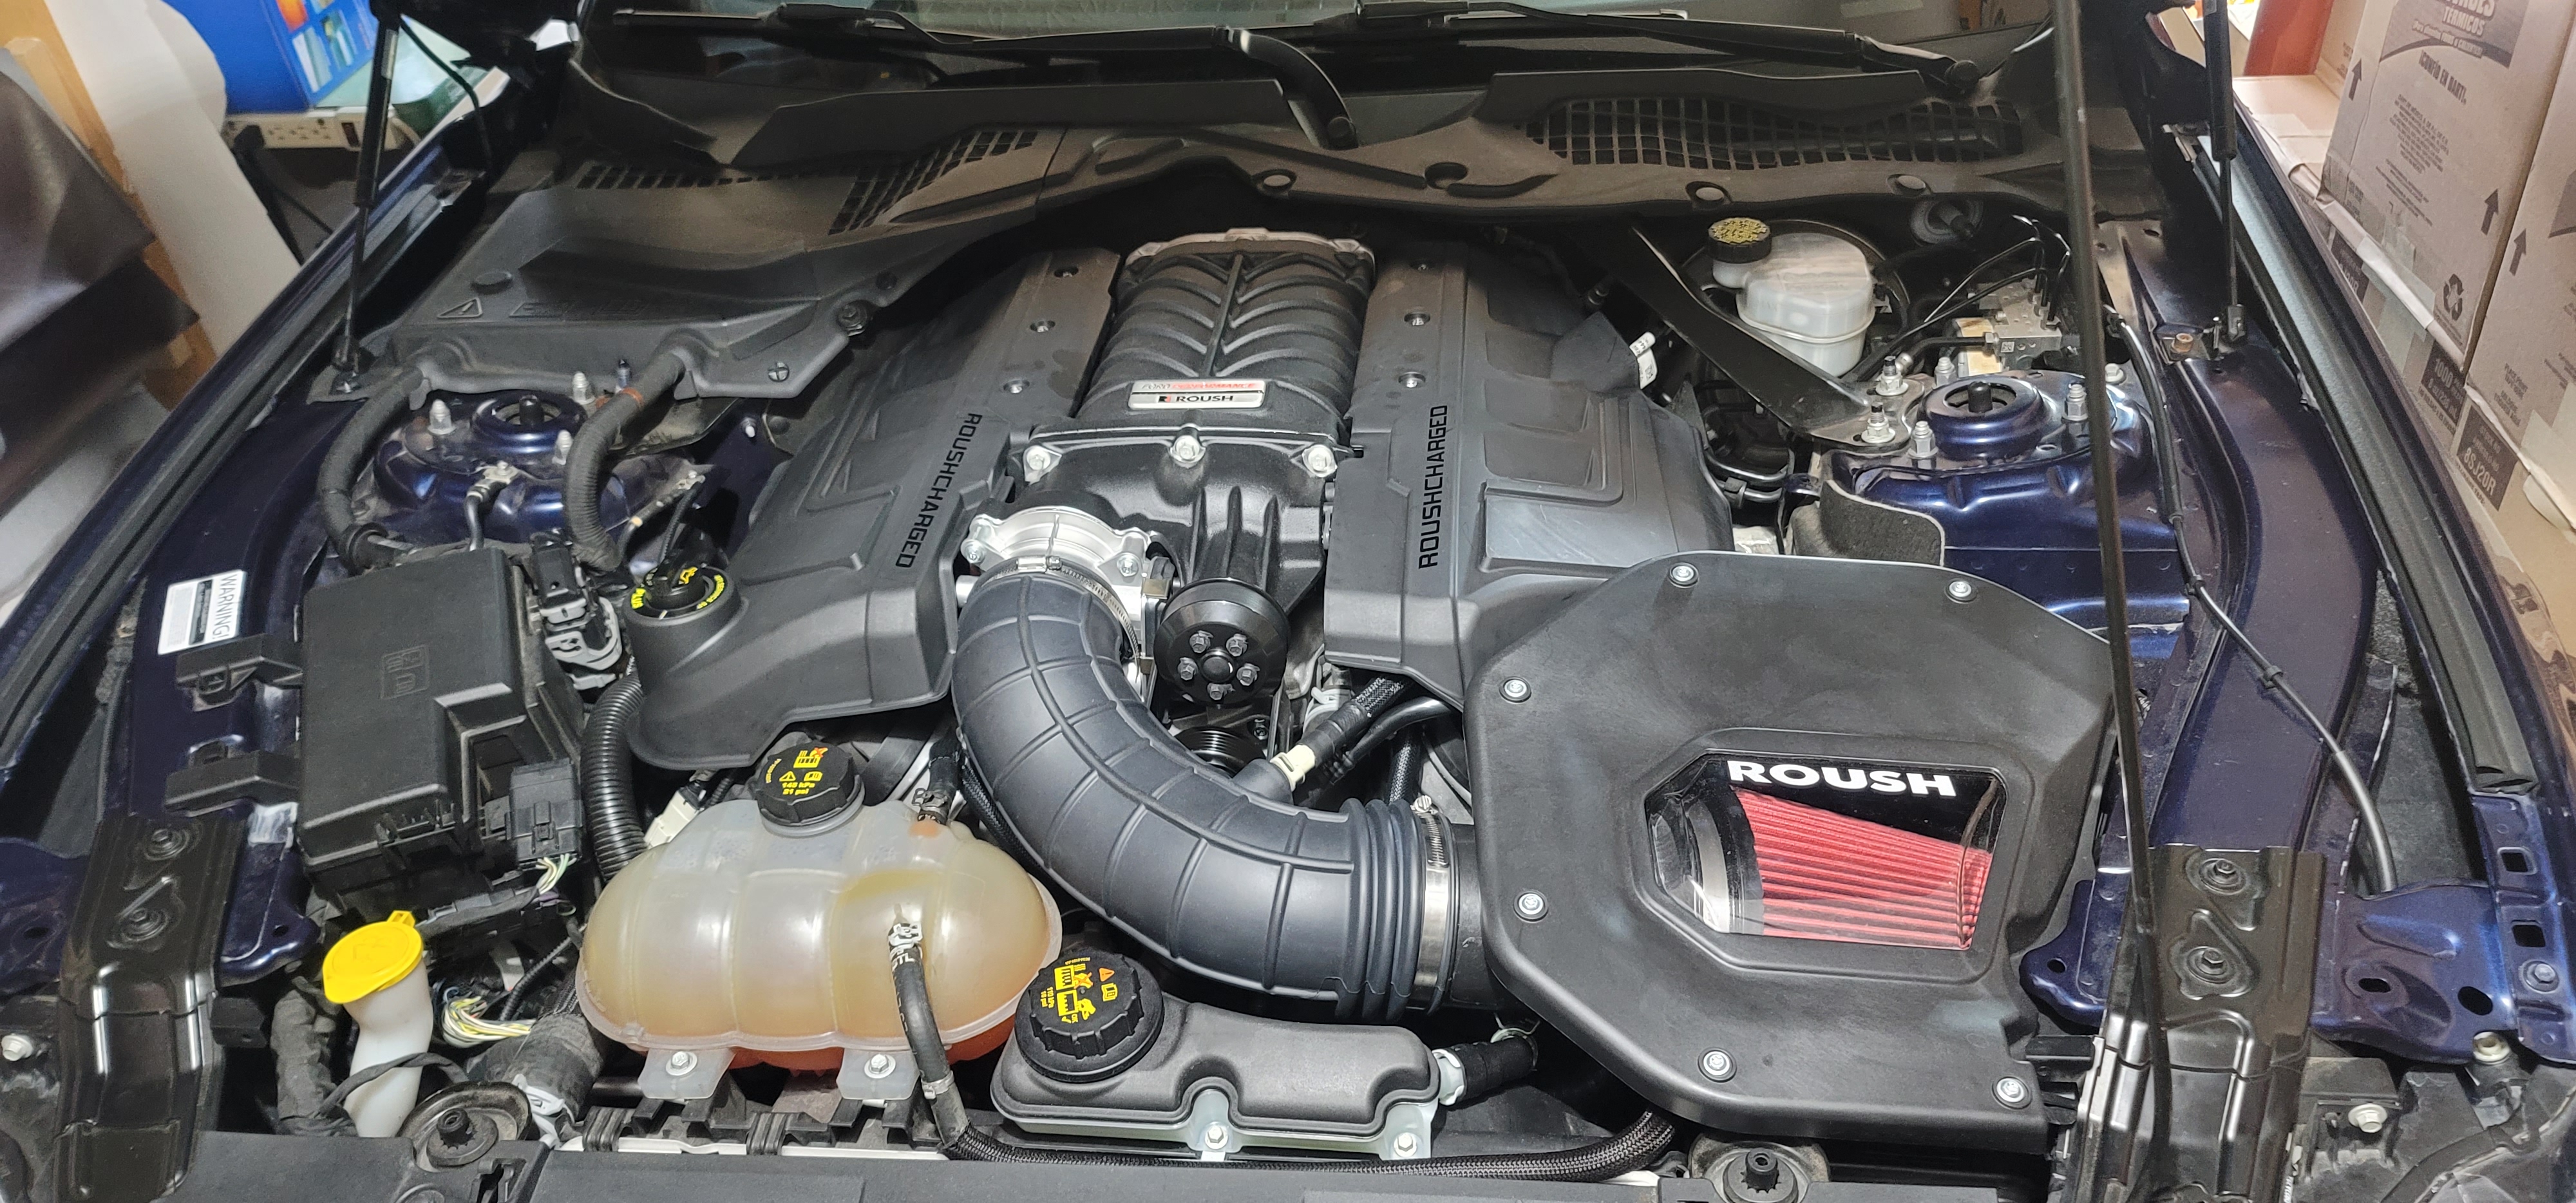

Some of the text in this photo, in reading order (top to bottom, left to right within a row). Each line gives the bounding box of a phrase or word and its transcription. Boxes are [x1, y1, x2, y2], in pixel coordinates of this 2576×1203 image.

[2434, 358, 2454, 388] 1000
[895, 412, 983, 568] ROUSHCHARGED
[1418, 405, 1448, 569] ROUSHCHARGED
[2464, 447, 2496, 496] 8SJ20R
[212, 574, 238, 639] WARNING!
[1727, 760, 1956, 797] ROUSH
[1071, 1013, 1079, 1024] OK
